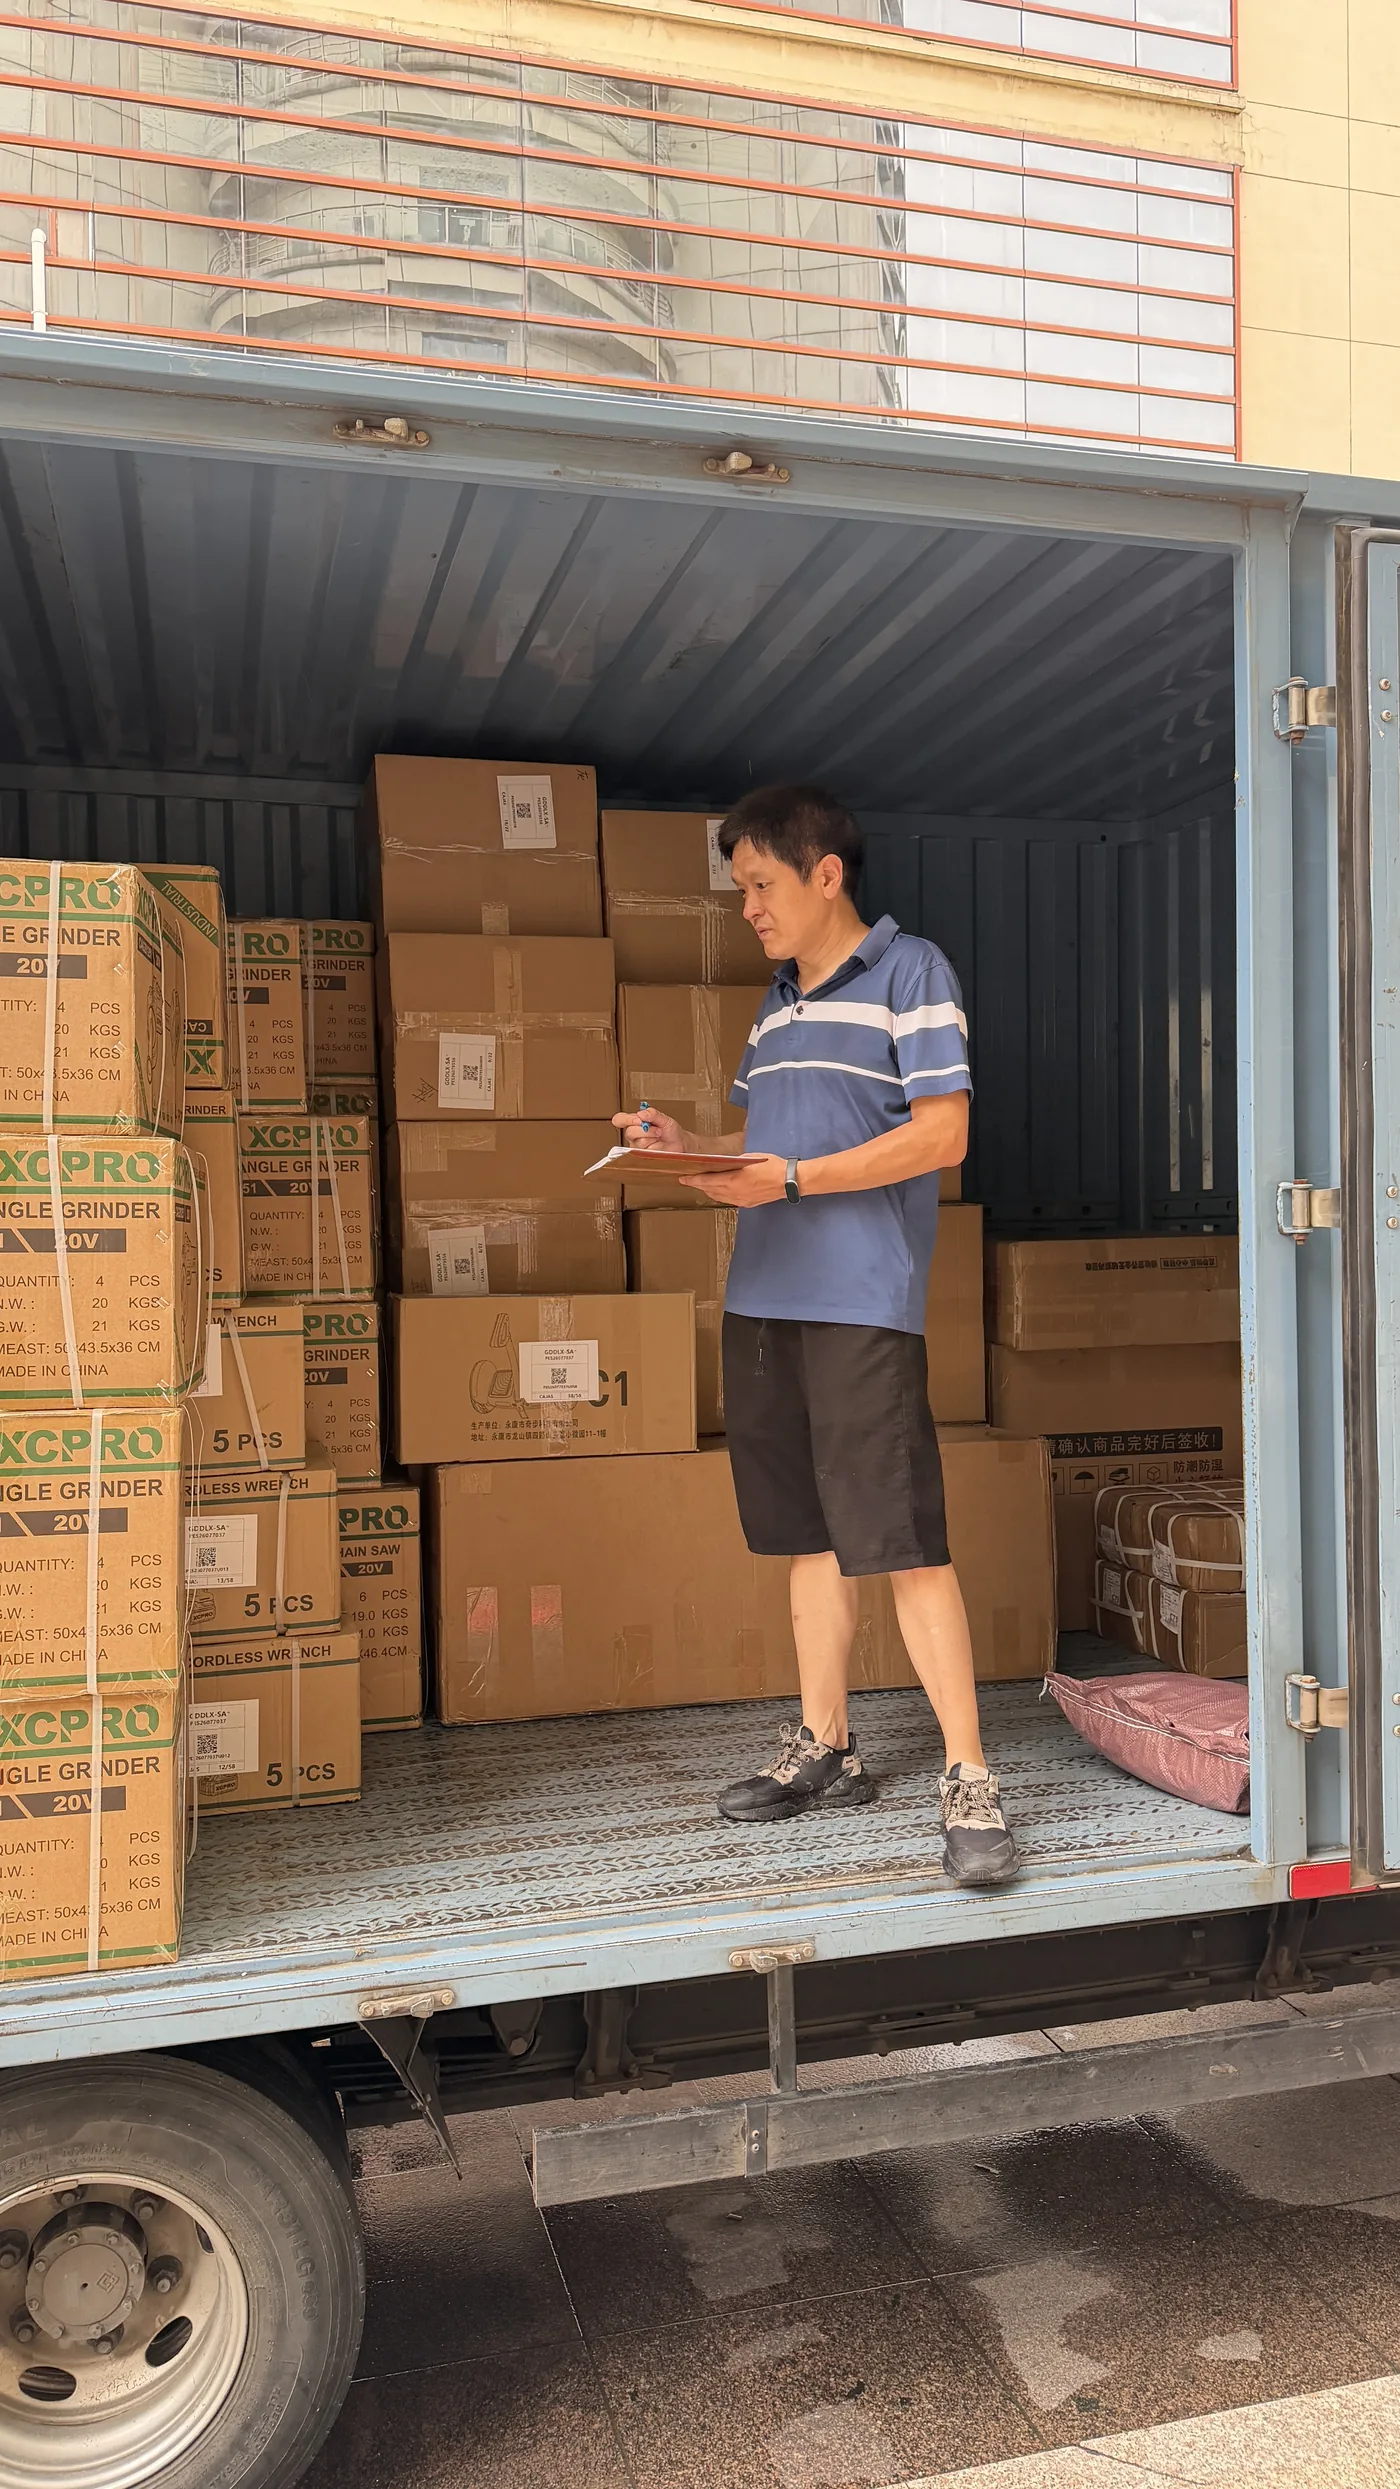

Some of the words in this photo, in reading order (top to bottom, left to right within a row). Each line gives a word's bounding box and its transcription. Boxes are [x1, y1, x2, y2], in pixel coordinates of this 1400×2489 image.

[161, 880, 218, 938] INDUSTRIAL
[23, 926, 121, 946] GRNDER
[57, 1002, 66, 1012] 4
[90, 1002, 121, 1015] PCS
[348, 1004, 366, 1012] PCS
[54, 1023, 69, 1035] 20
[89, 1024, 121, 1037] KGS
[249, 1020, 255, 1028] 4
[272, 1020, 293, 1029] PCS
[247, 1035, 259, 1044] 20
[272, 1035, 294, 1044] KGS
[54, 1047, 68, 1058] 21
[89, 1047, 121, 1059] KGS
[248, 1051, 259, 1060] 21
[273, 1051, 295, 1060] KGS
[98, 1069, 121, 1081] CM
[279, 1066, 295, 1075] CM
[4, 1089, 18, 1101] IN
[23, 1089, 70, 1102] CHNA
[0, 1150, 161, 1183] XCPRO
[293, 1160, 360, 1173] GRNDER
[62, 1202, 161, 1219] GRINDER
[250, 1211, 305, 1221] QUANTITY:
[340, 1210, 361, 1219] PCS
[96, 1275, 104, 1287] 4
[129, 1274, 161, 1287] PCS
[251, 1273, 281, 1282] MADE
[283, 1272, 294, 1281] IN
[92, 1298, 108, 1309] 20
[129, 1297, 161, 1309] KGS
[92, 1320, 107, 1332] 21
[129, 1320, 161, 1332] KGS
[213, 1315, 277, 1328] WENCH
[54, 1341, 133, 1354] 5043.5x36
[137, 1341, 160, 1353] CM
[304, 1349, 370, 1362] GRINDER
[42, 1365, 56, 1376] IN
[327, 1400, 334, 1408] 4
[349, 1398, 371, 1407] PCS
[325, 1415, 337, 1423] 20
[349, 1413, 371, 1422] KGS
[325, 1431, 336, 1439] 21
[349, 1429, 371, 1438] KGS
[0, 1426, 163, 1464] XCPRO
[213, 1429, 229, 1453] 5
[238, 1432, 282, 1450] PCS
[355, 1444, 371, 1453] CM
[1173, 1459, 1223, 1474] 防潮防湿
[60, 1479, 163, 1500] GRNDER
[370, 1544, 401, 1556] SAW
[131, 1554, 162, 1567] PCS
[358, 1563, 384, 1574] 20V
[129, 1577, 162, 1589] KGS
[359, 1592, 367, 1602] 6
[382, 1588, 408, 1600] PCS
[129, 1600, 162, 1613] KGS
[244, 1593, 260, 1617] 5
[193, 1611, 213, 1621] XCPRO
[351, 1610, 376, 1622] 19.0
[382, 1608, 408, 1620] KGS
[53, 1623, 133, 1640] 50x4.5x36
[138, 1622, 162, 1635] CM
[382, 1625, 409, 1637] KGS
[40, 1651, 55, 1664] IN
[60, 1648, 109, 1662] CHIA
[0, 1704, 160, 1747] XCPRO
[59, 1756, 161, 1781] GRNDER
[266, 1763, 283, 1787] 5
[129, 1831, 160, 1845] PCS
[129, 1853, 161, 1867] KGS
[129, 1876, 161, 1890] KGS
[54, 1900, 133, 1919] 50x45x36
[138, 1897, 161, 1911] CM
[41, 1930, 56, 1943] IN
[61, 1925, 109, 1940] CHIA
